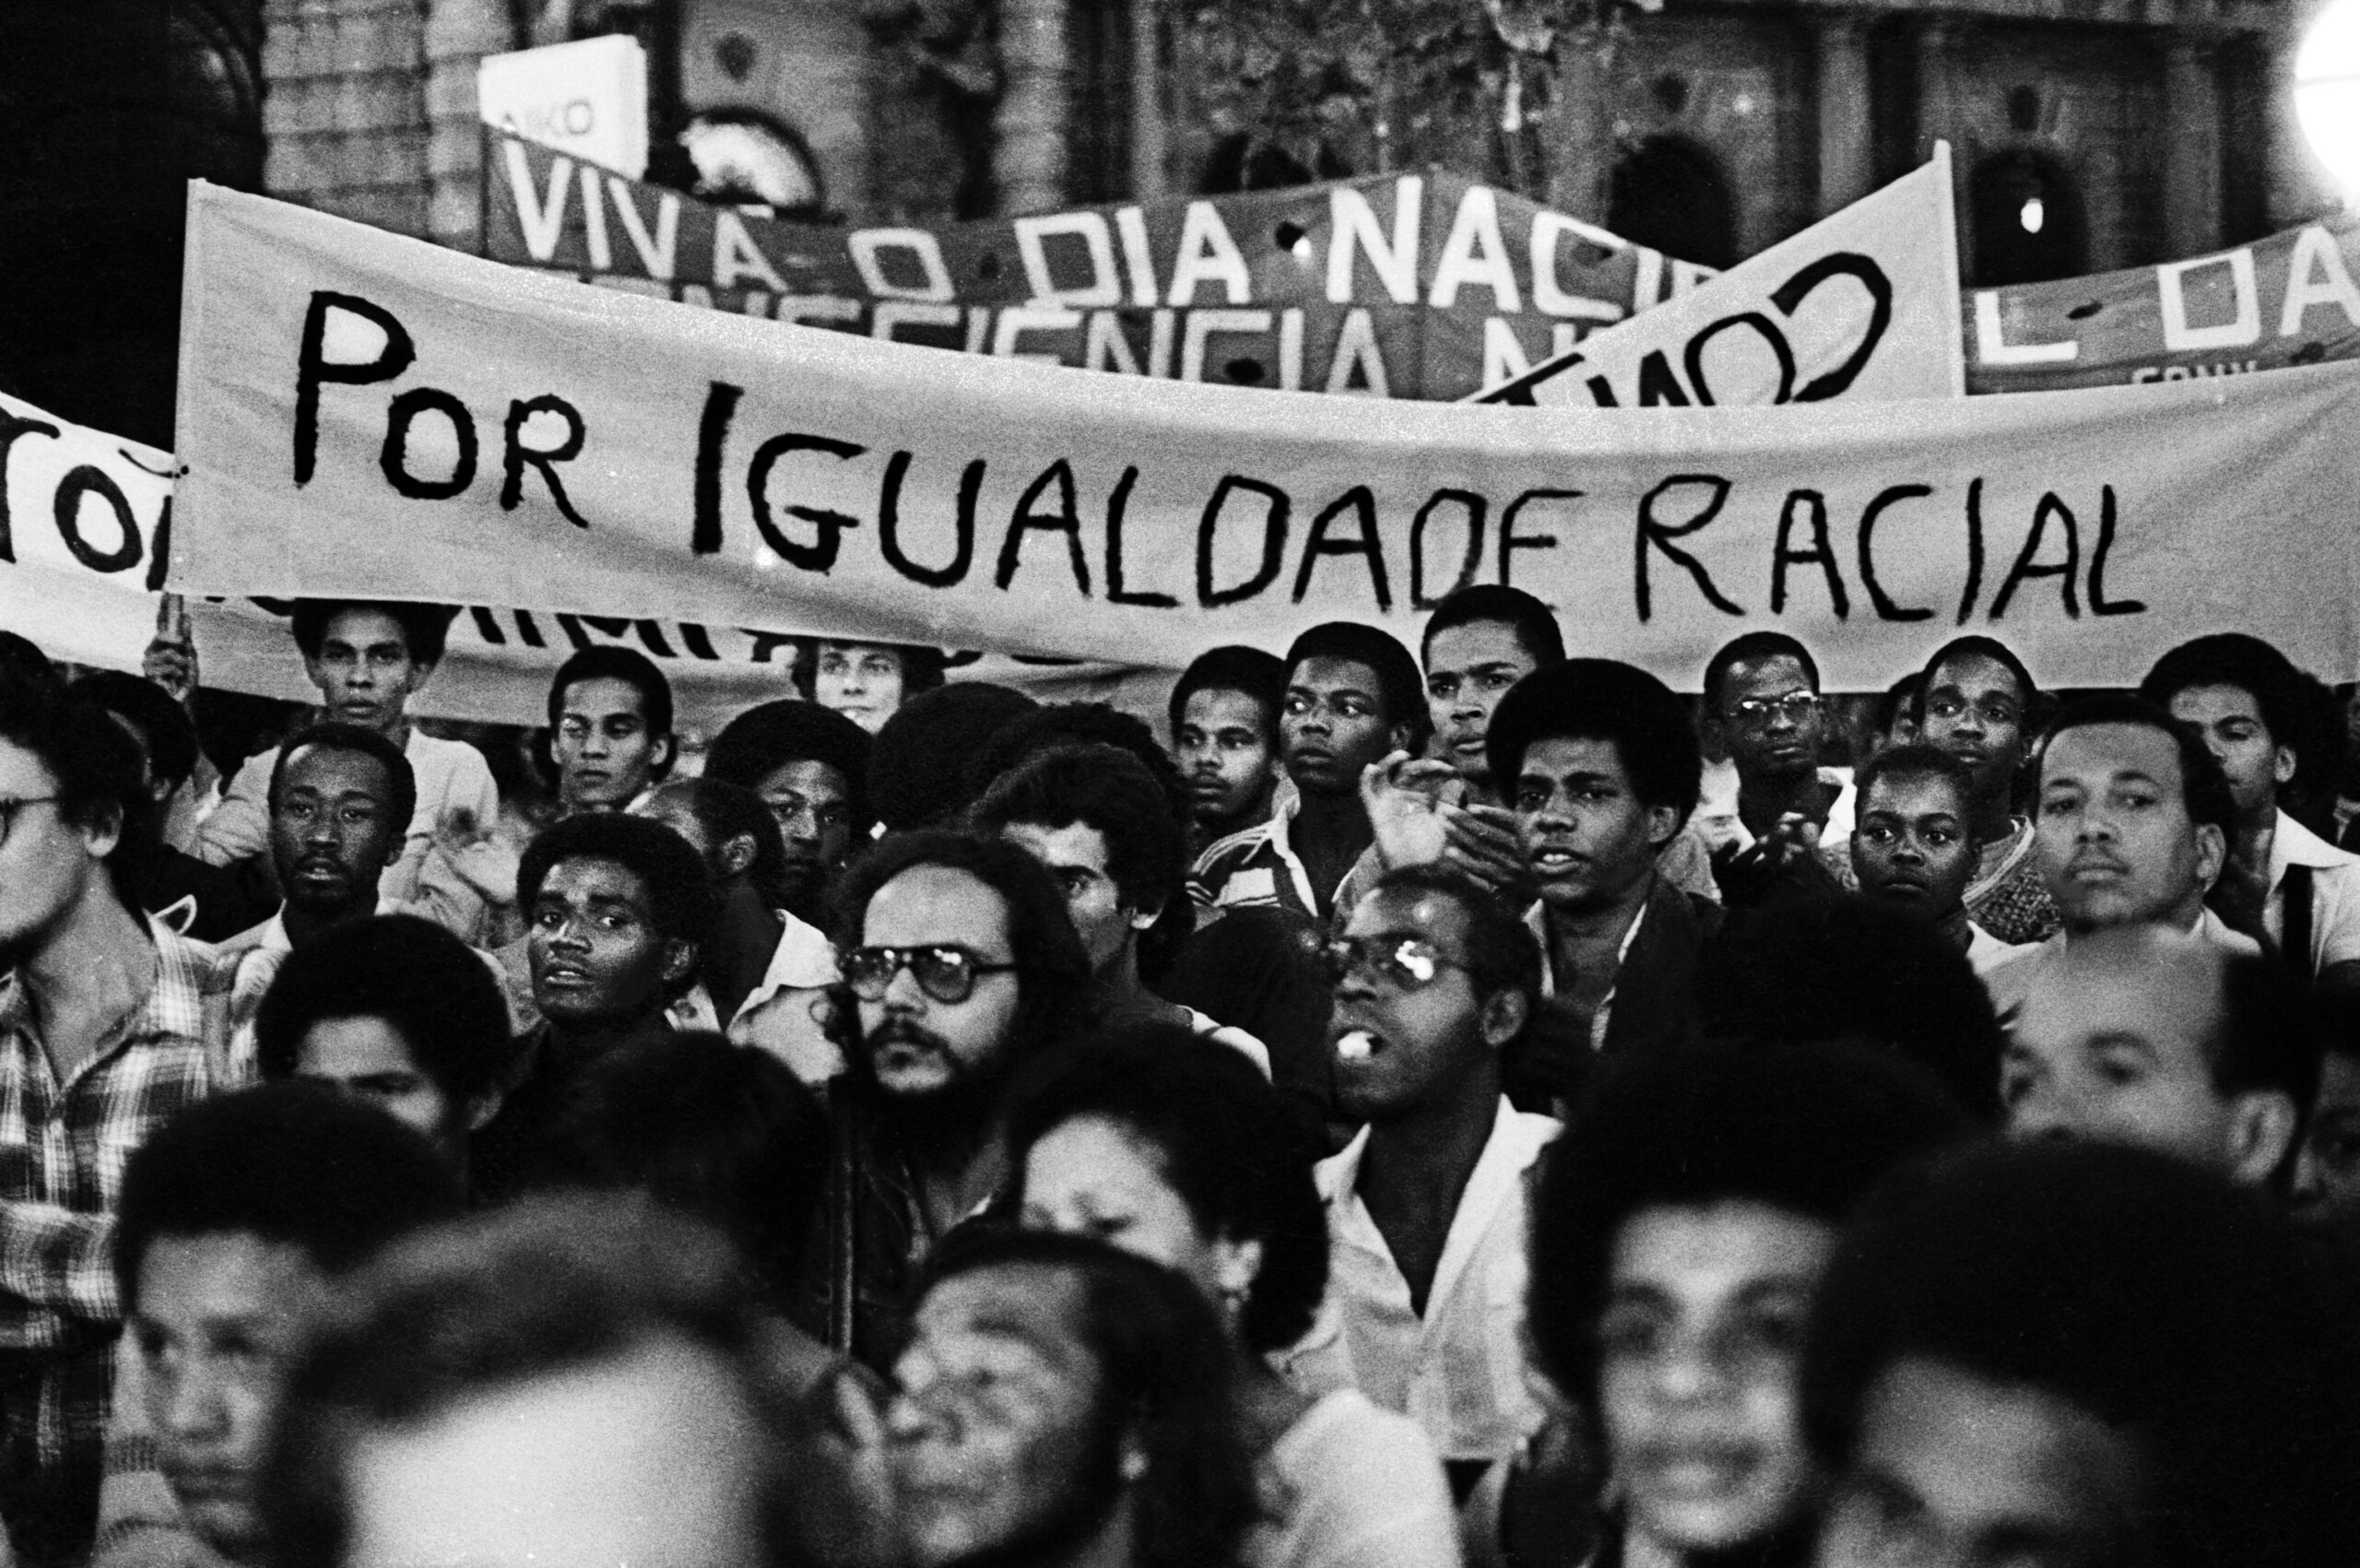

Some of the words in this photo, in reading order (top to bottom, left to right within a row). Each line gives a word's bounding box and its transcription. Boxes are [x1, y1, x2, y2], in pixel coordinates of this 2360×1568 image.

[504, 138, 789, 294] VIVA
[847, 227, 956, 302] O
[1014, 198, 1251, 308] DIA
[691, 381, 1587, 612] IGUALDADE
[1634, 473, 2148, 626] RACIAL
